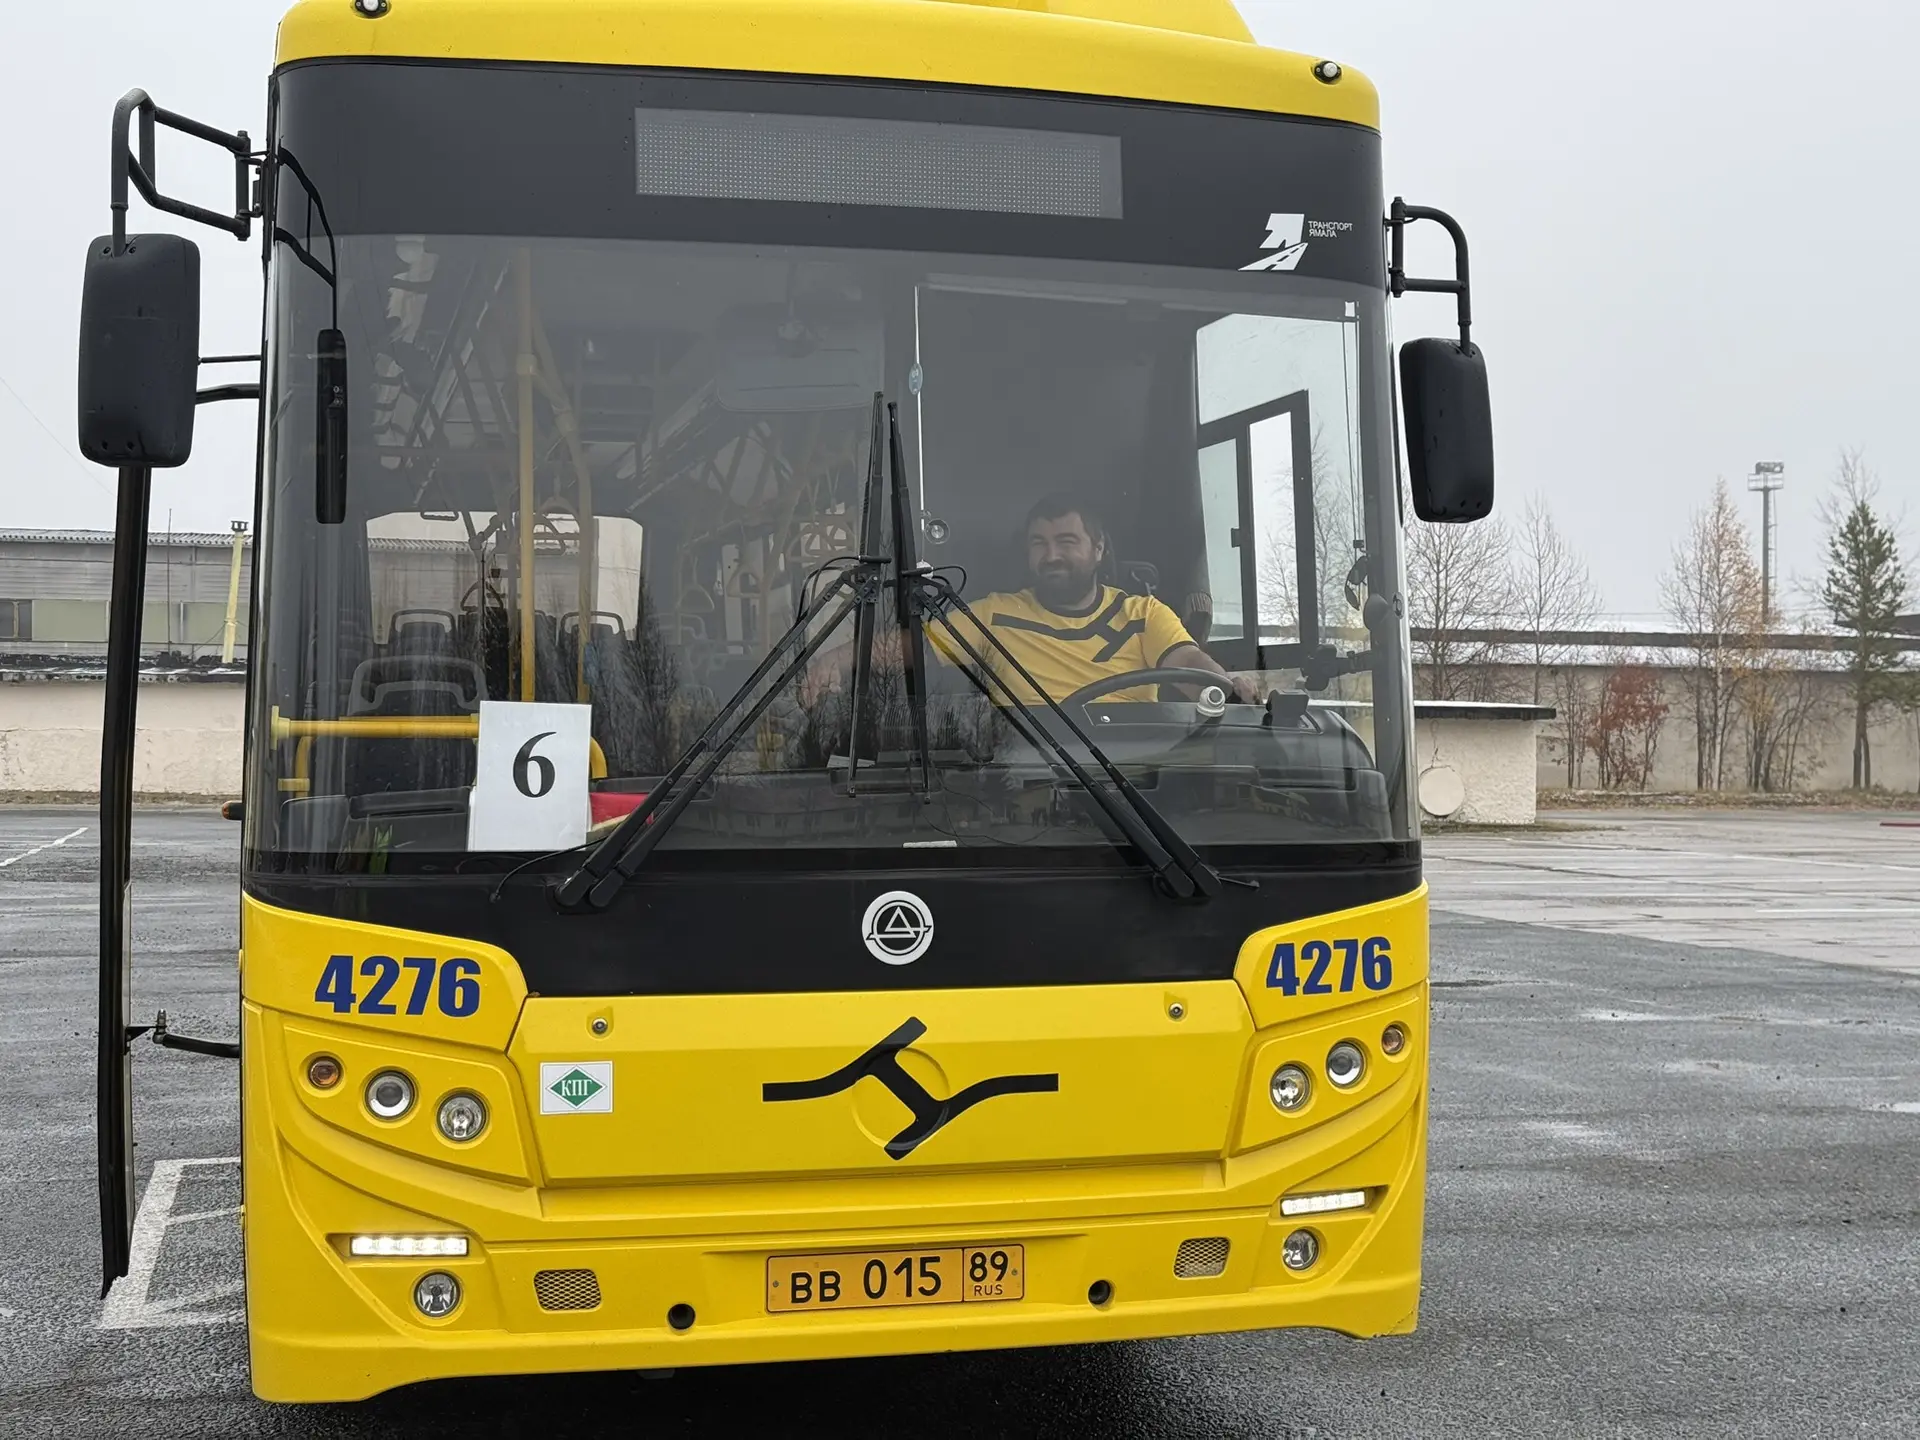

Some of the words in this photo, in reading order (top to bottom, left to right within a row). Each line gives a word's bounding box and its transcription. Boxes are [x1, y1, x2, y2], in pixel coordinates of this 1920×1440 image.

[1308, 220, 1353, 232] ТРАНСПОРТ
[1309, 229, 1337, 238] ЯМАЛА
[512, 731, 557, 798] 6
[1265, 936, 1393, 997] 4276
[314, 954, 481, 1018] 4276
[561, 1079, 593, 1097] КПГ
[863, 1255, 942, 1300] 015
[969, 1250, 1009, 1283] 89
[973, 1284, 1004, 1297] RUS
